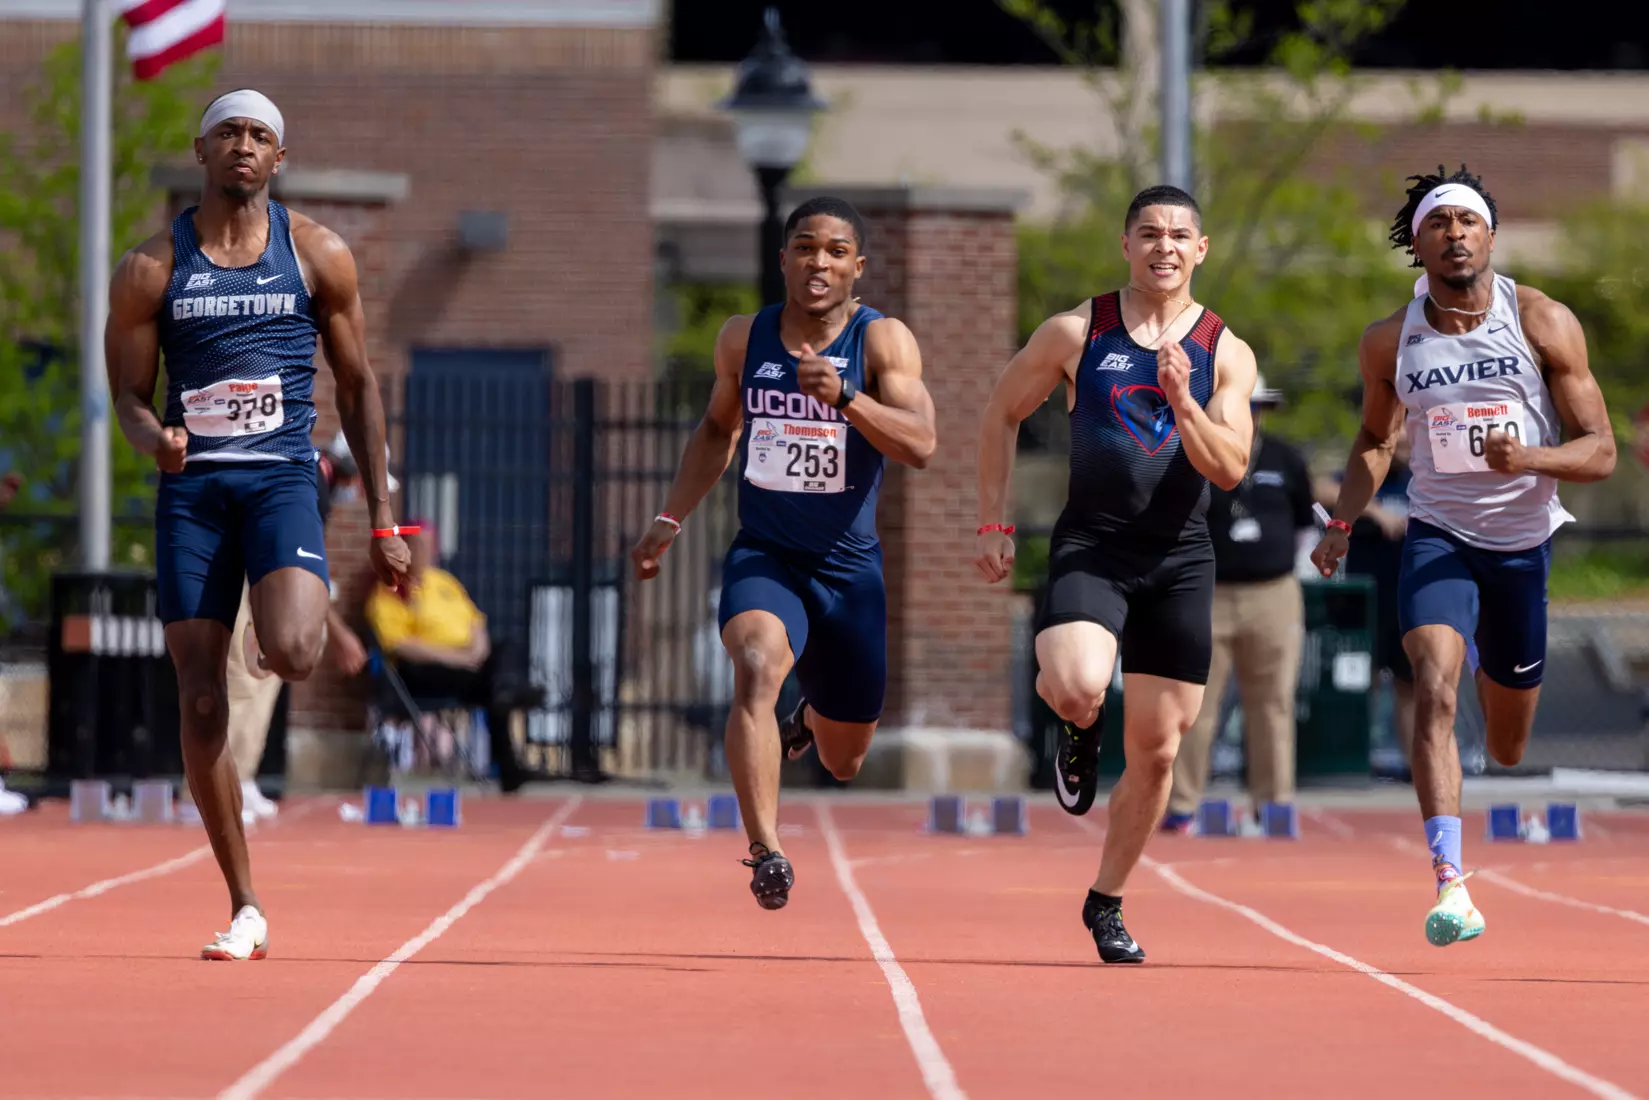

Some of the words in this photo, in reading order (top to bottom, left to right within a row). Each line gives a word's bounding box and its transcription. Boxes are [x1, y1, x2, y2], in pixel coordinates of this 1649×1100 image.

[187, 279, 217, 287] EAST
[172, 293, 296, 320] GEORGETOWN
[1105, 353, 1130, 362] BIG
[762, 361, 783, 371] BIG
[1099, 360, 1134, 370] EAST
[756, 368, 786, 378] EAST
[1405, 356, 1523, 394] XAVIER
[228, 382, 258, 392] Paige
[1467, 405, 1508, 418] Bennett
[784, 423, 837, 437] Thompson
[786, 443, 838, 478] 253
